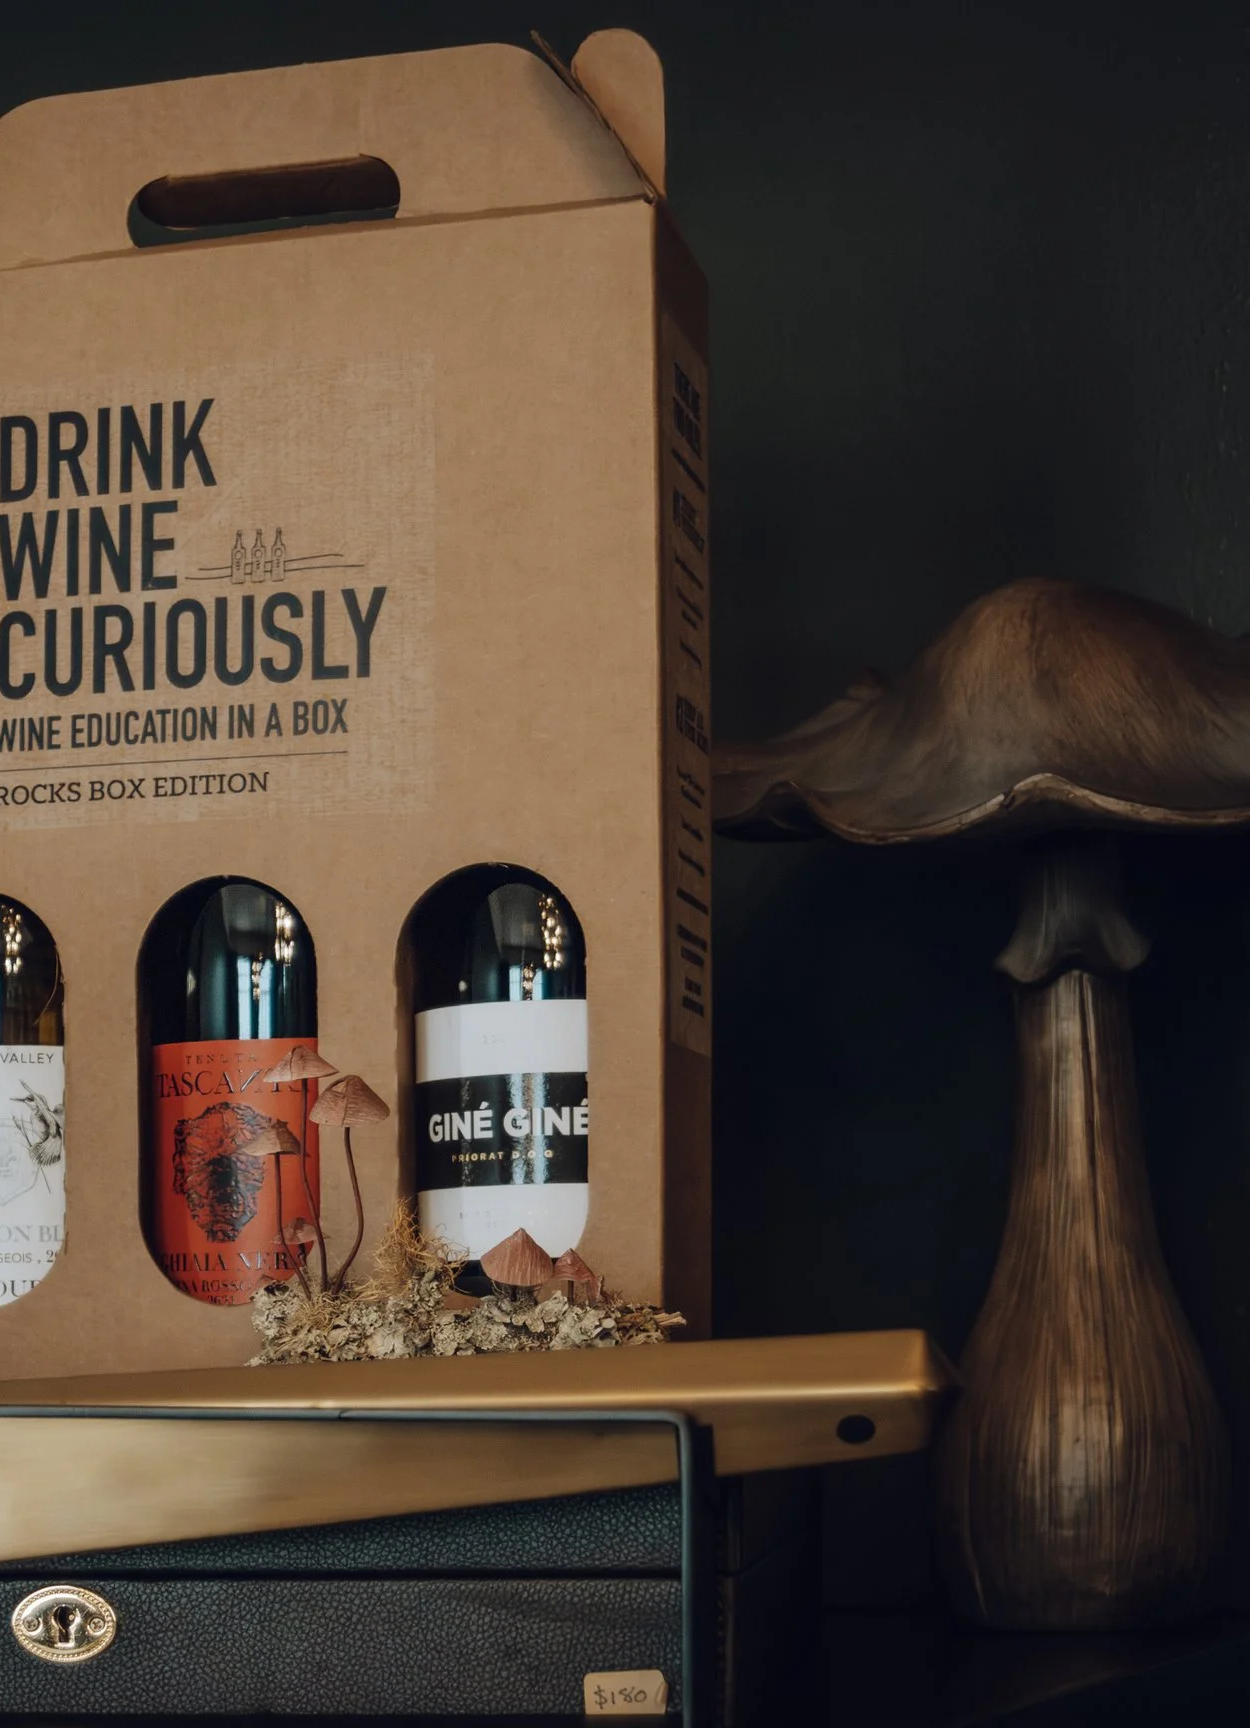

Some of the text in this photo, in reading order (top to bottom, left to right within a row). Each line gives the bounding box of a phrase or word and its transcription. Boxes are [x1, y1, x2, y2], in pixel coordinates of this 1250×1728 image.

[71, 706, 217, 749] EDUCATION
[229, 704, 251, 739] IN
[264, 703, 283, 738] A
[293, 698, 348, 736] BOX
[88, 776, 146, 802] BOX
[153, 771, 270, 799] EDITION
[0, 1052, 55, 1064] VALLEY
[428, 1100, 588, 1143] GINÉ GINÉ
[451, 1151, 505, 1163] PRIORAT
[593, 1685, 648, 1709] $180
